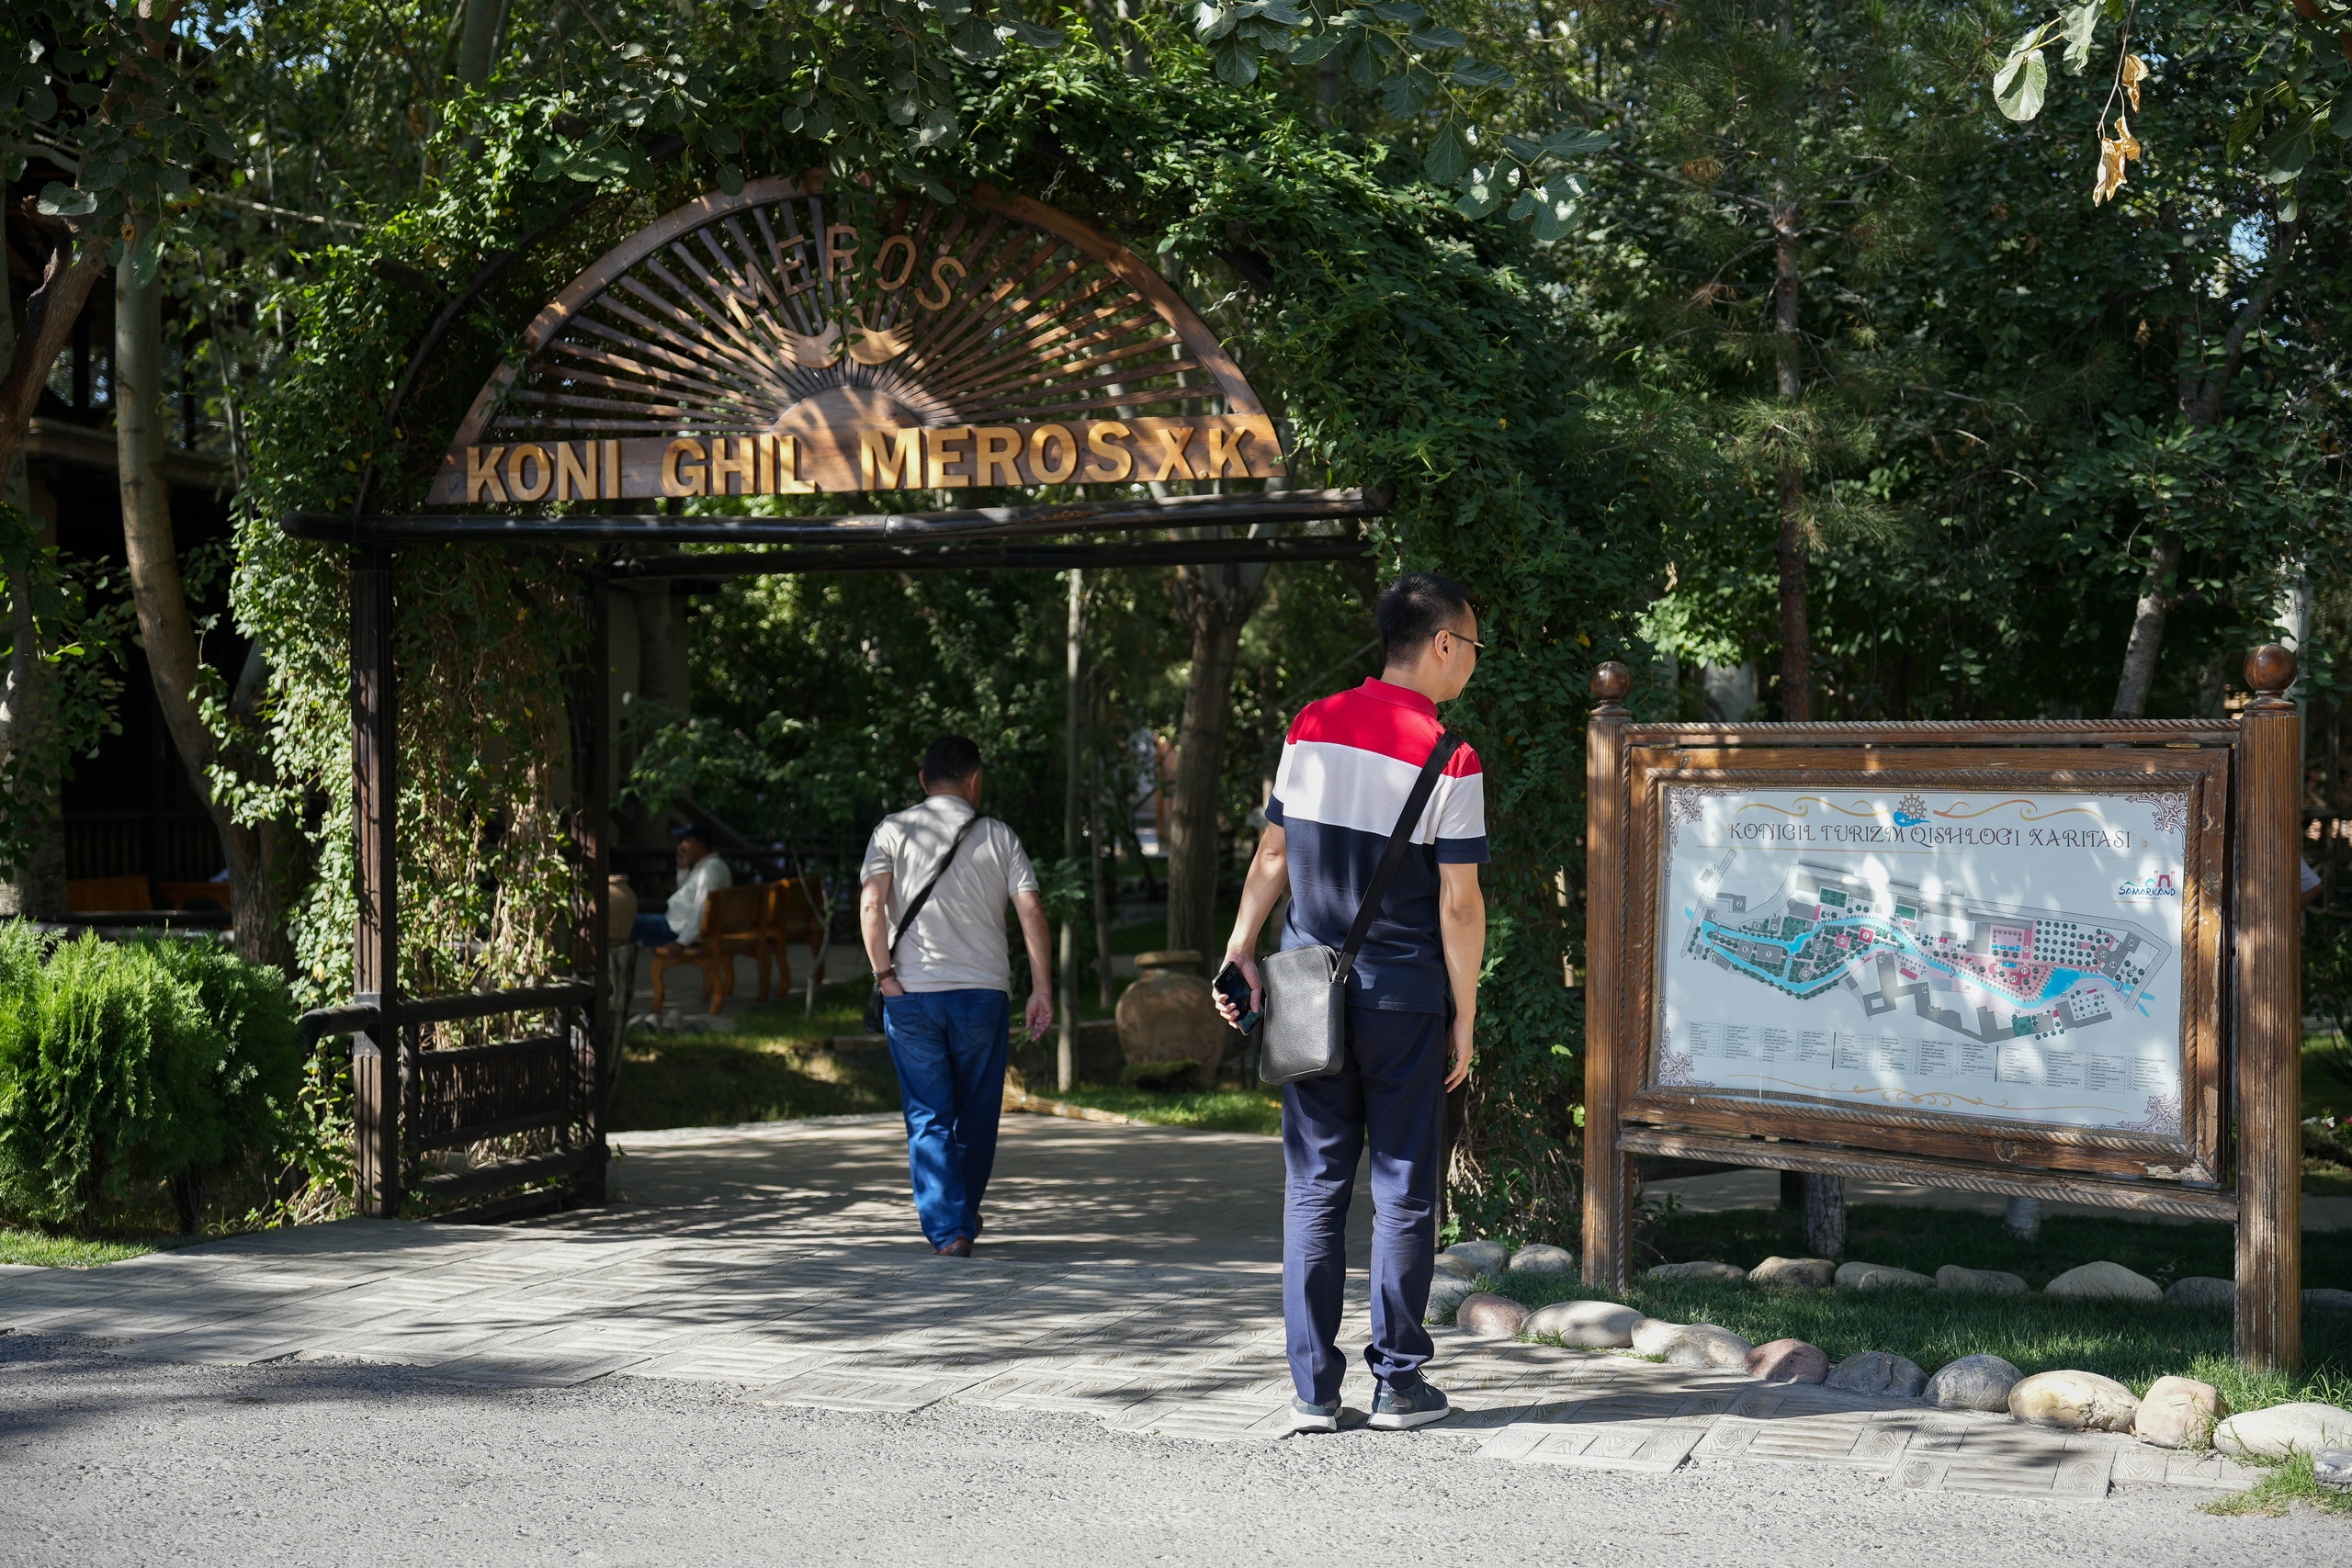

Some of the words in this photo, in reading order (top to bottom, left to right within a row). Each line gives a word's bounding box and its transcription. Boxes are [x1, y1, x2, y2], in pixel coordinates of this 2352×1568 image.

[720, 225, 967, 330] MEROS
[467, 439, 621, 502] KONI
[662, 434, 816, 497] GHIL
[861, 421, 1132, 491] MEROS
[1727, 822, 1817, 841] KONIGIL
[1820, 824, 1906, 843] TURIZM
[2029, 828, 2132, 848] XARITASI
[2118, 886, 2177, 897] SAMARKAND
